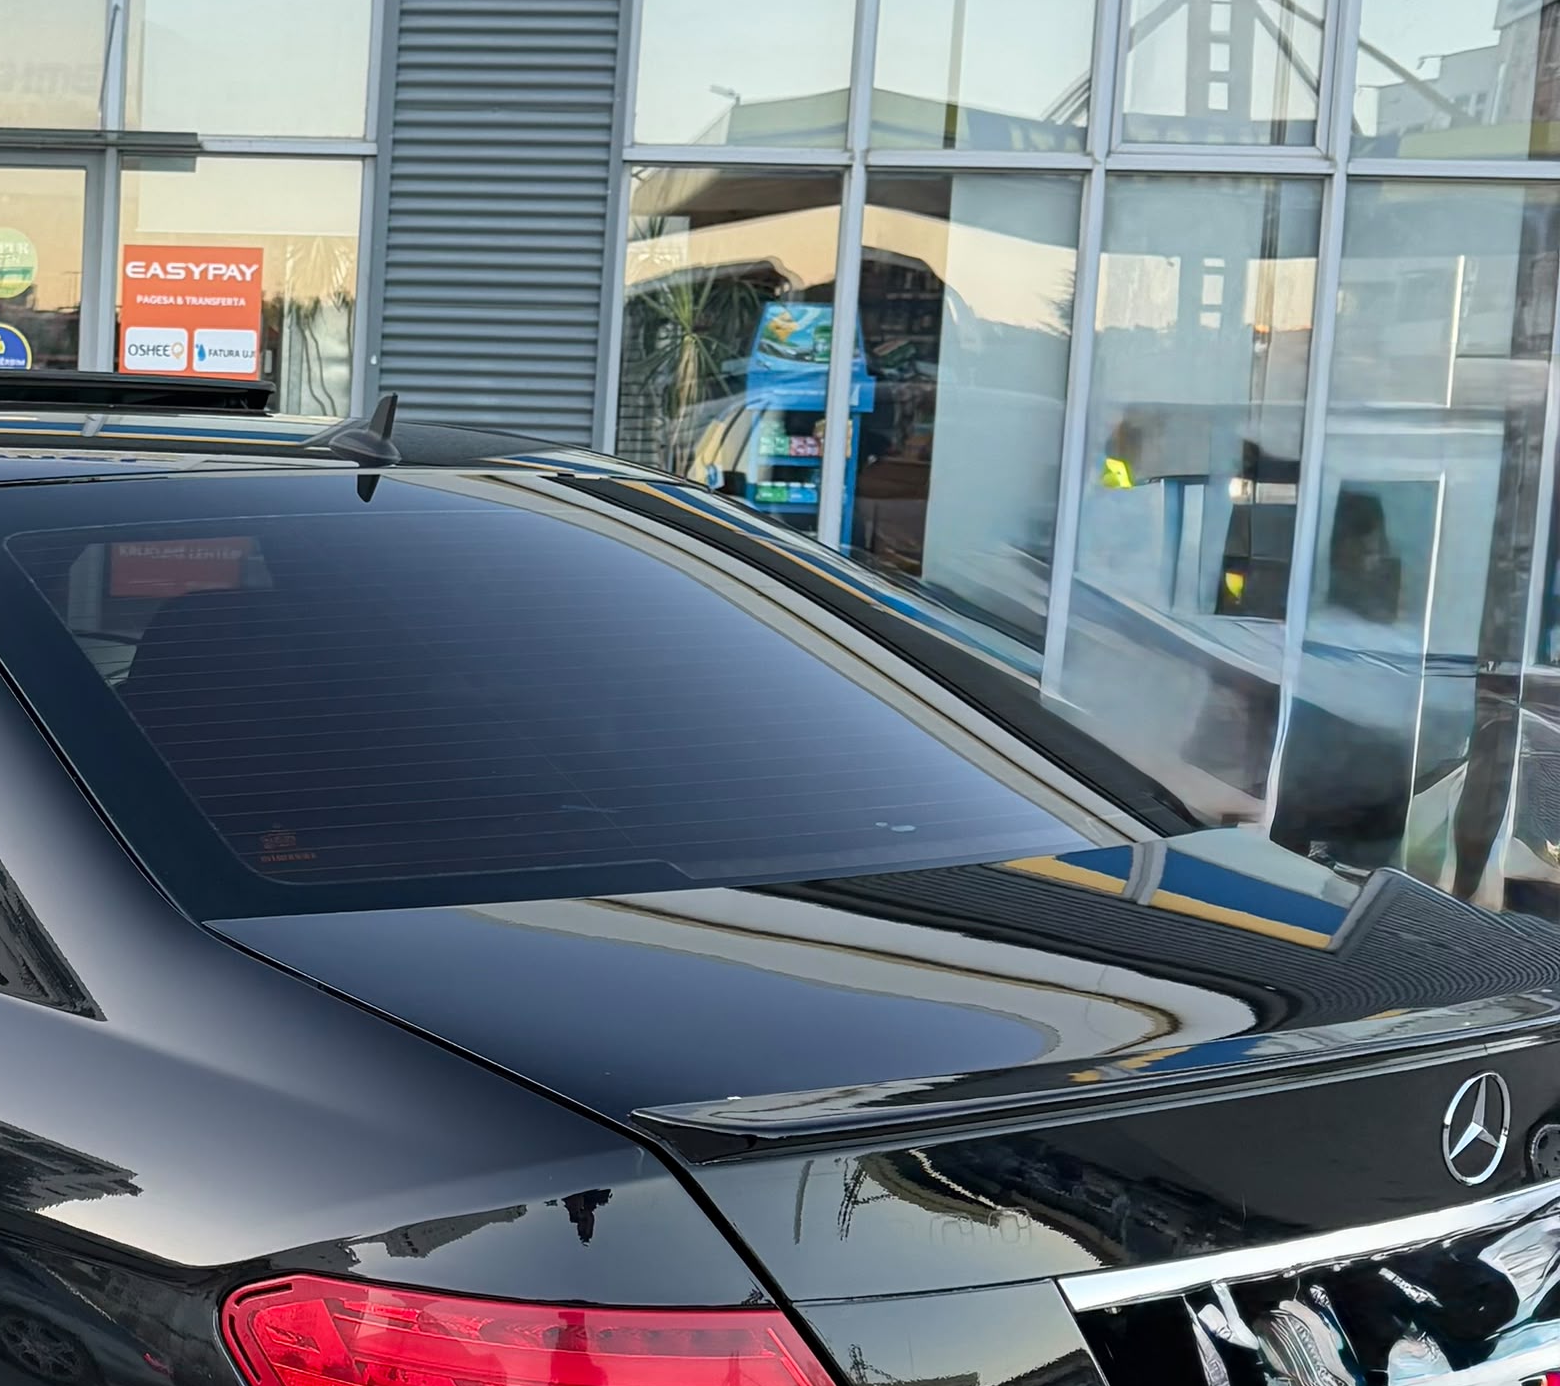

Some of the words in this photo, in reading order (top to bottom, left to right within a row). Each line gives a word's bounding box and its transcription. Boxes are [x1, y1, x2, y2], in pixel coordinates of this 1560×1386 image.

[125, 261, 258, 281] EASYPAY
[136, 295, 173, 305] PAGESA
[185, 296, 246, 307] TRANSFERTA
[128, 343, 171, 358] OSHEE
[208, 348, 239, 358] FATURA
